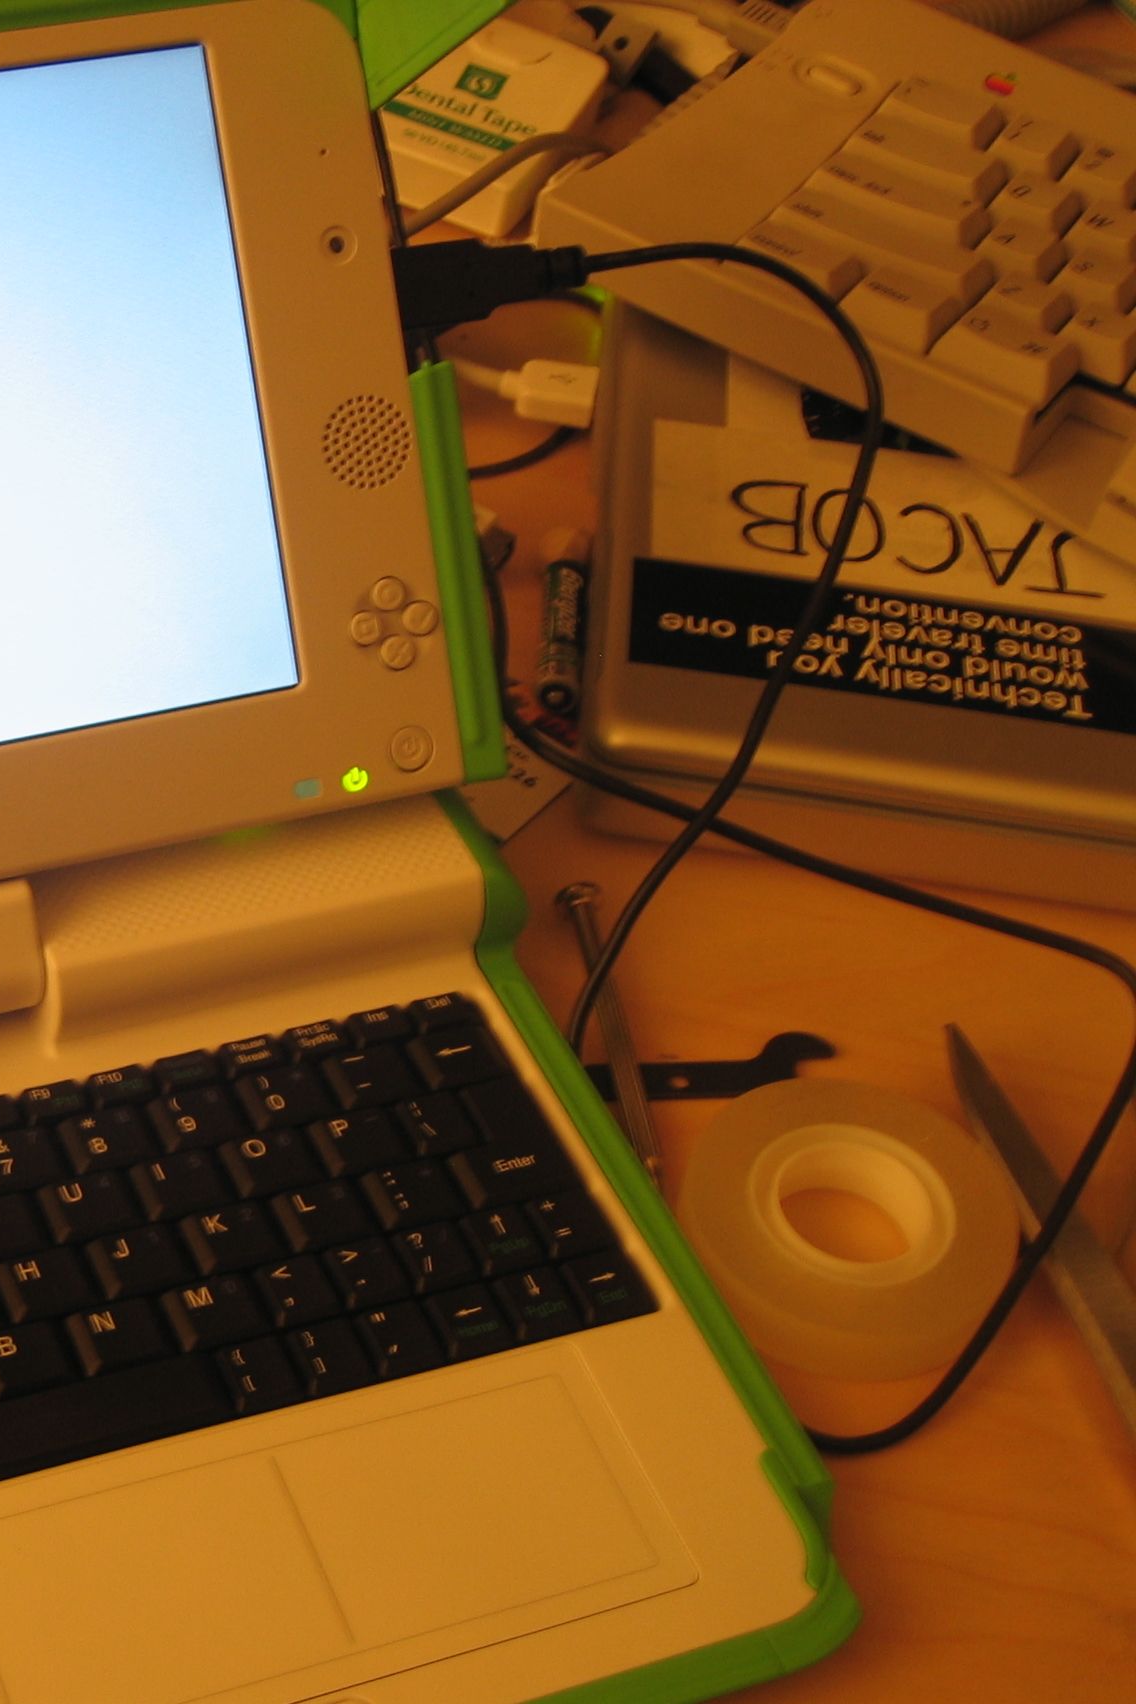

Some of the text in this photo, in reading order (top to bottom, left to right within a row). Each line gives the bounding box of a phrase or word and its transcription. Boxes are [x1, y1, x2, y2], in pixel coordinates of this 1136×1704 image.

[483, 106, 537, 134] Tape
[730, 479, 1106, 599] JACOB
[659, 611, 737, 638] one
[843, 593, 1084, 646] convention.
[828, 612, 1087, 671] time traveler
[862, 634, 951, 668] only
[964, 655, 1091, 691] would
[855, 658, 1093, 720] Technically
[425, 995, 452, 1010] Del
[366, 1009, 389, 1023] Ins
[95, 1070, 123, 1087] F10
[30, 1086, 52, 1103] F9
[177, 1115, 198, 1134] 9
[328, 1118, 350, 1139] P
[87, 1136, 108, 1155] 8
[493, 1152, 538, 1174] Enter
[60, 1181, 85, 1204] U
[292, 1193, 317, 1214] L
[200, 1213, 230, 1236] K
[111, 1238, 131, 1260] J
[13, 1260, 43, 1283] H
[183, 1285, 214, 1309] M
[88, 1309, 117, 1333] N
